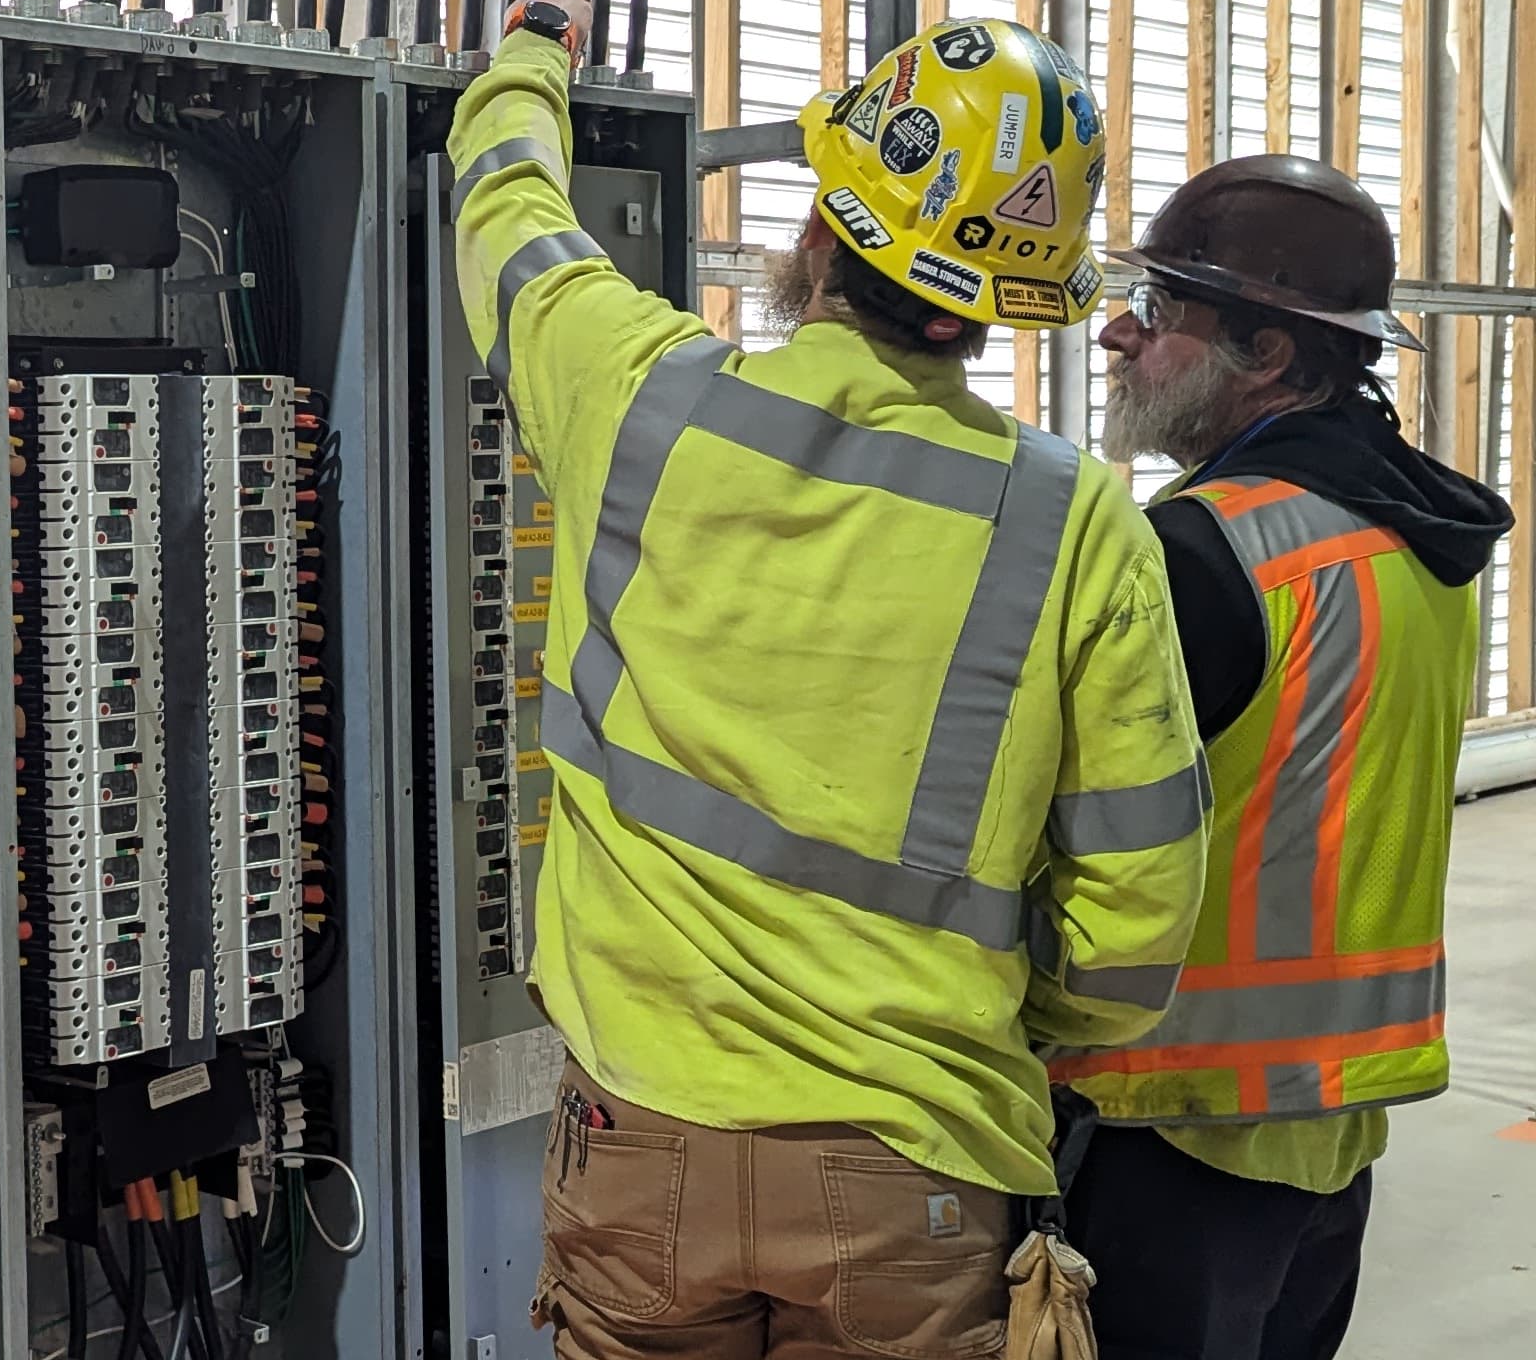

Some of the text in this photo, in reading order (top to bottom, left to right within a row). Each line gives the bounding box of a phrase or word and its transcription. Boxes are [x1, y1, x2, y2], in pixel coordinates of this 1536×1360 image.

[892, 124, 914, 150] WHILE
[901, 119, 935, 150] AWAY!
[1000, 104, 1020, 159] JUMPER
[883, 153, 901, 173] THIS
[886, 139, 912, 167] FIX
[827, 188, 892, 246] WTF?
[960, 220, 1059, 261] RIOT
[938, 269, 962, 286] STUPID
[961, 279, 978, 294] KILLS
[1003, 287, 1025, 299] MUST
[1027, 289, 1035, 300] BE
